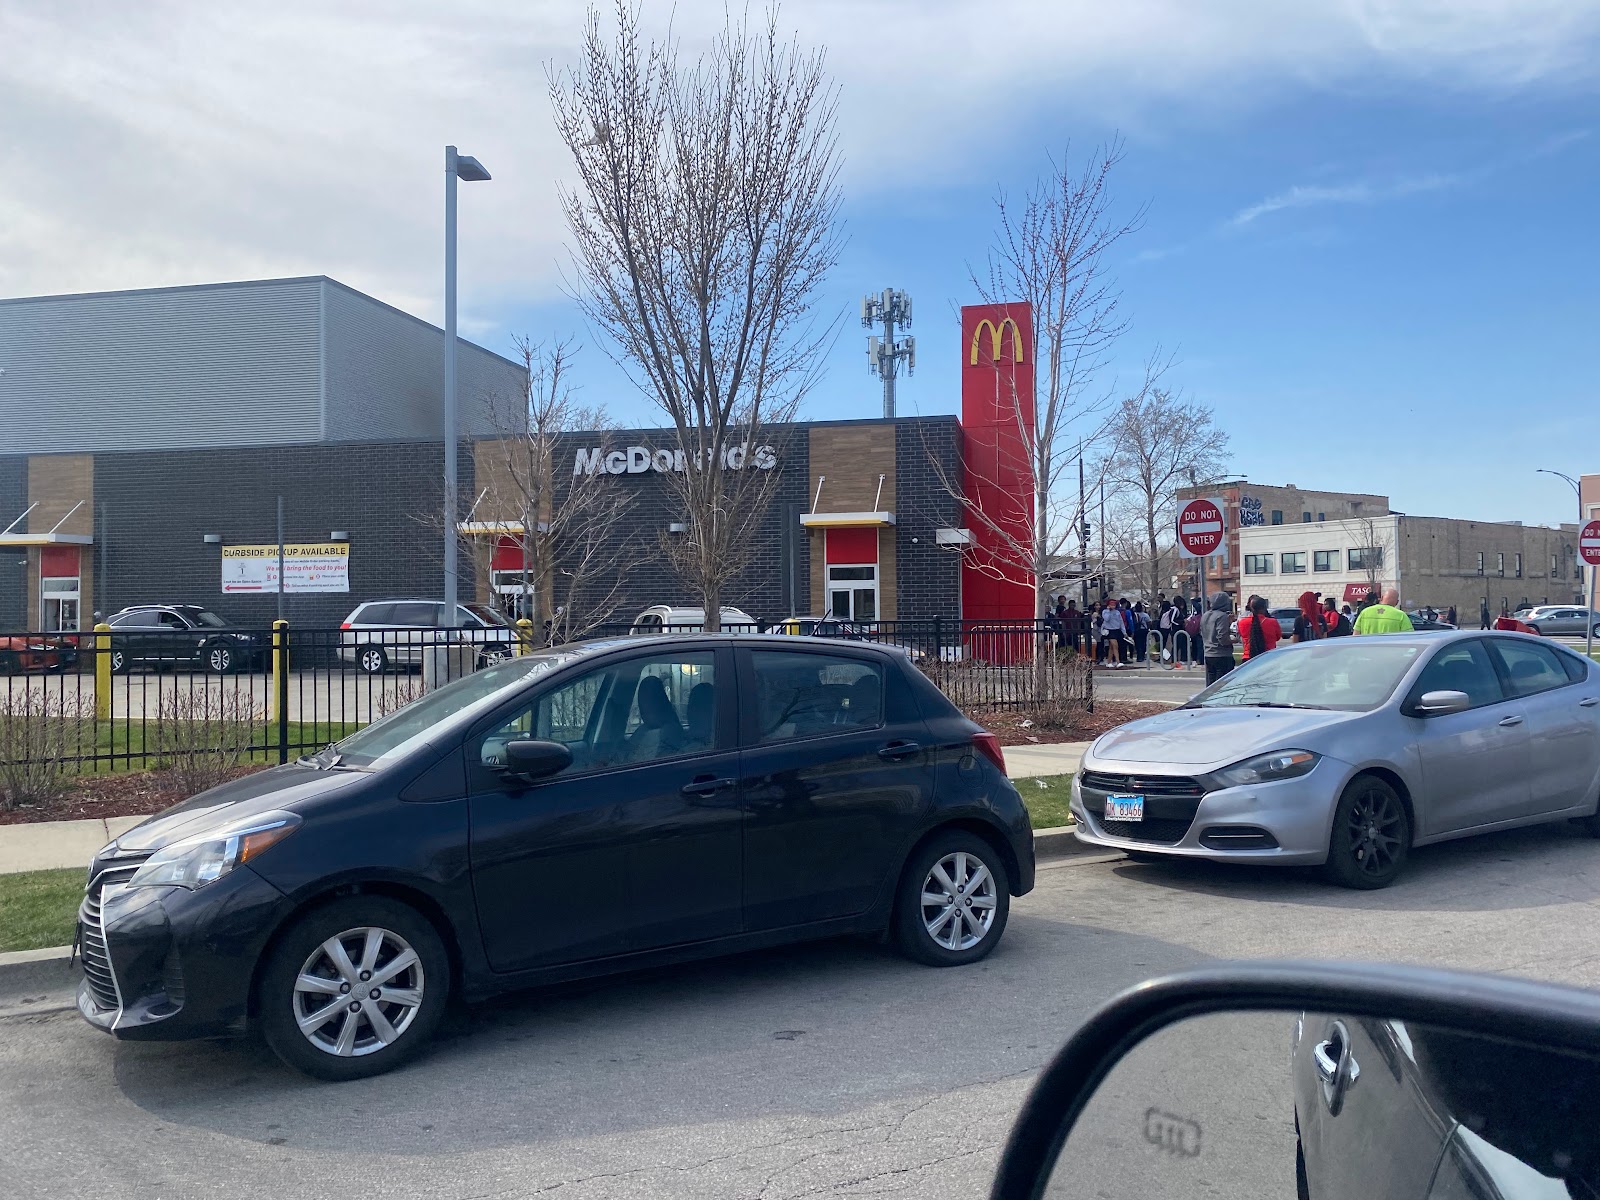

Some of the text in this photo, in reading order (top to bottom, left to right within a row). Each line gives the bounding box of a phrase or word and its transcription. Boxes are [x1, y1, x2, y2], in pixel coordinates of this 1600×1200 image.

[1185, 509, 1217, 521] DO NOT
[1584, 528, 1594, 537] DO
[1189, 535, 1215, 546] ENTER
[223, 549, 265, 557] CURBSIDE
[300, 547, 346, 556] AVAILABLE
[1585, 549, 1600, 557] ENTE
[286, 564, 302, 572] bring
[1119, 802, 1142, 817] 83466
